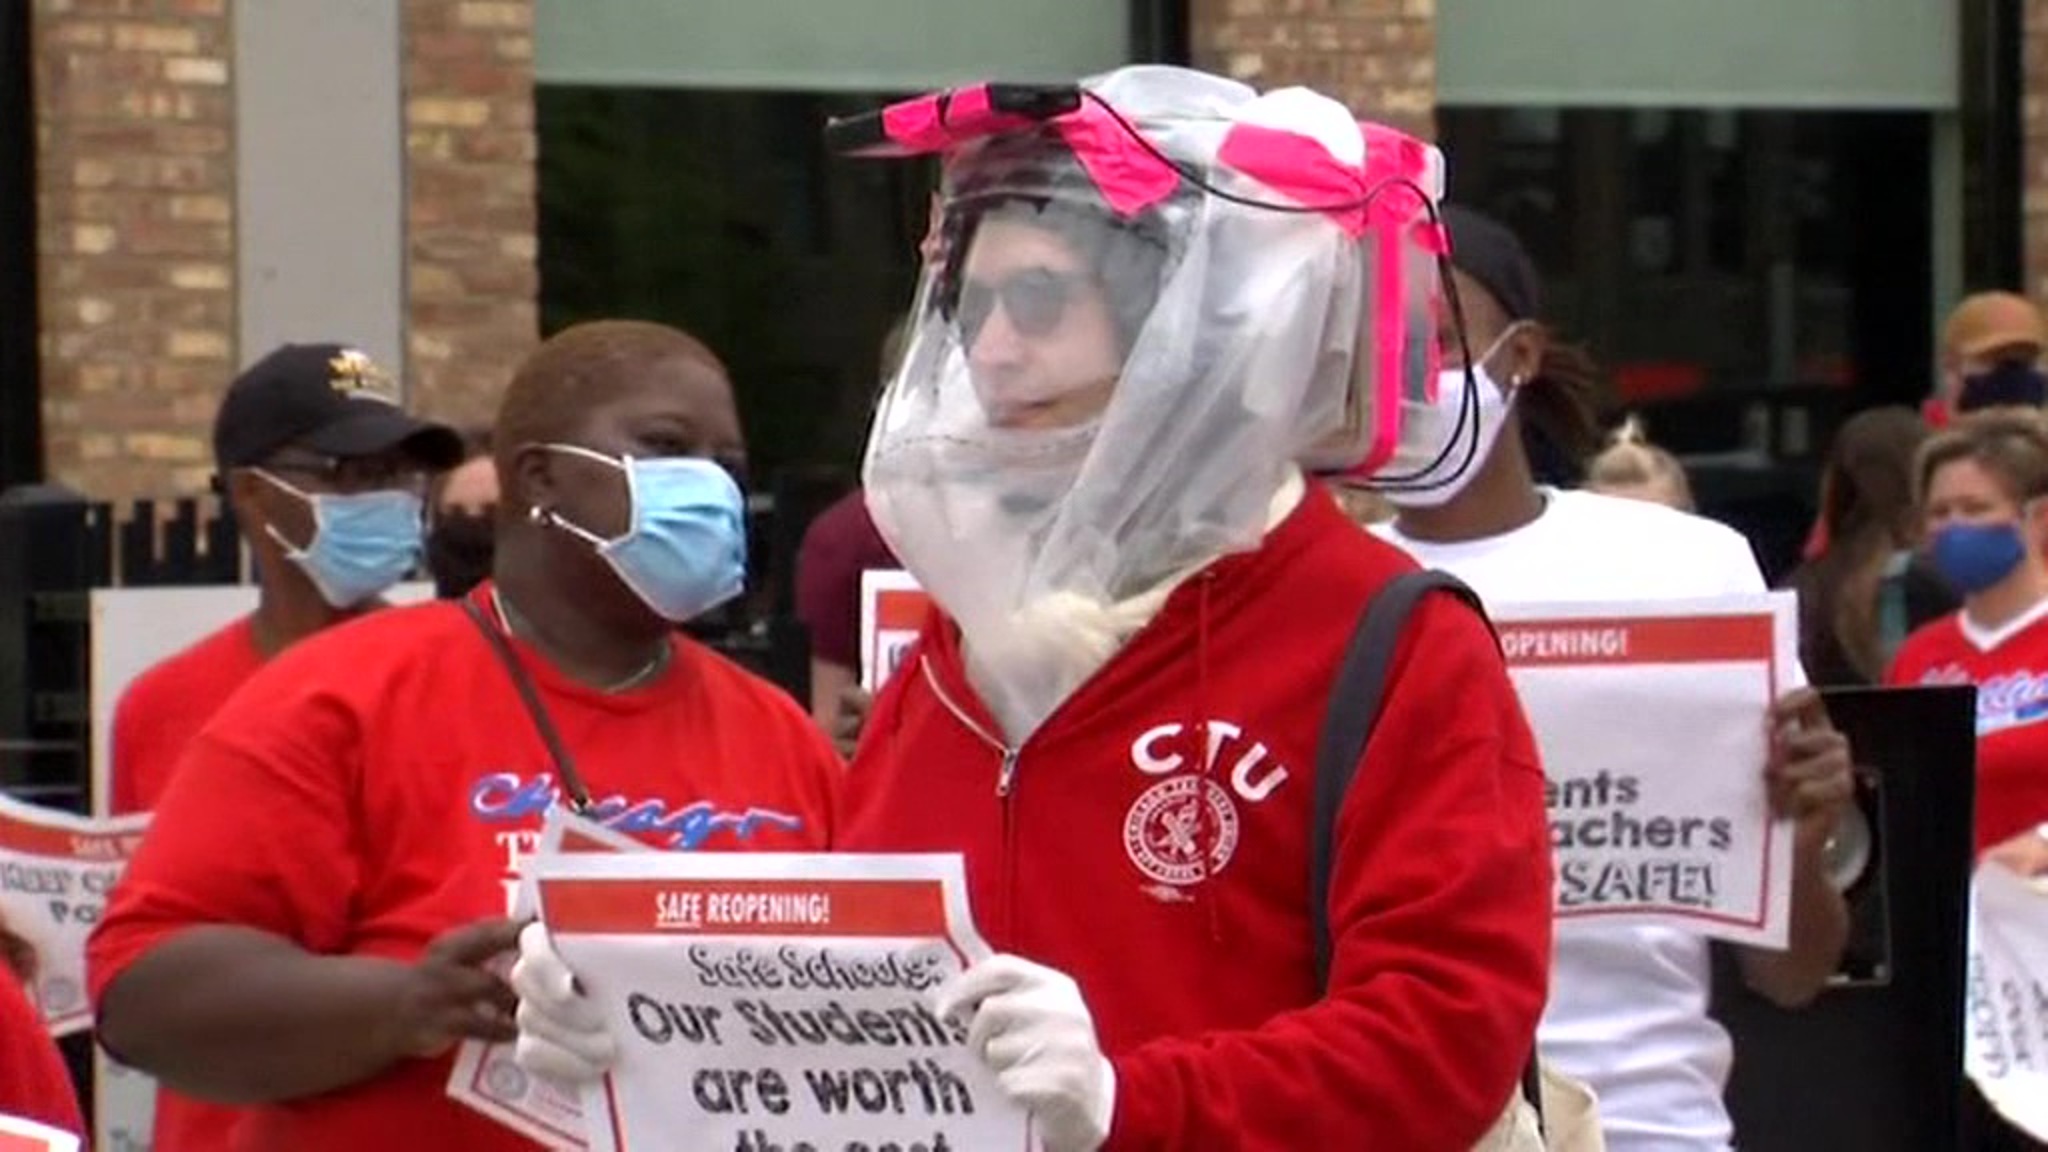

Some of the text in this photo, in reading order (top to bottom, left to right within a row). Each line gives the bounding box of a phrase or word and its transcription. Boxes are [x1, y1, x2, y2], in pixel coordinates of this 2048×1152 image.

[1131, 720, 1289, 801] CTU
[1559, 862, 1716, 907] SAFE!
[655, 892, 831, 927] SAFE REOPENING!
[689, 945, 783, 987] Safe
[628, 994, 969, 1046] Our Students
[692, 1058, 974, 1116] are worth
